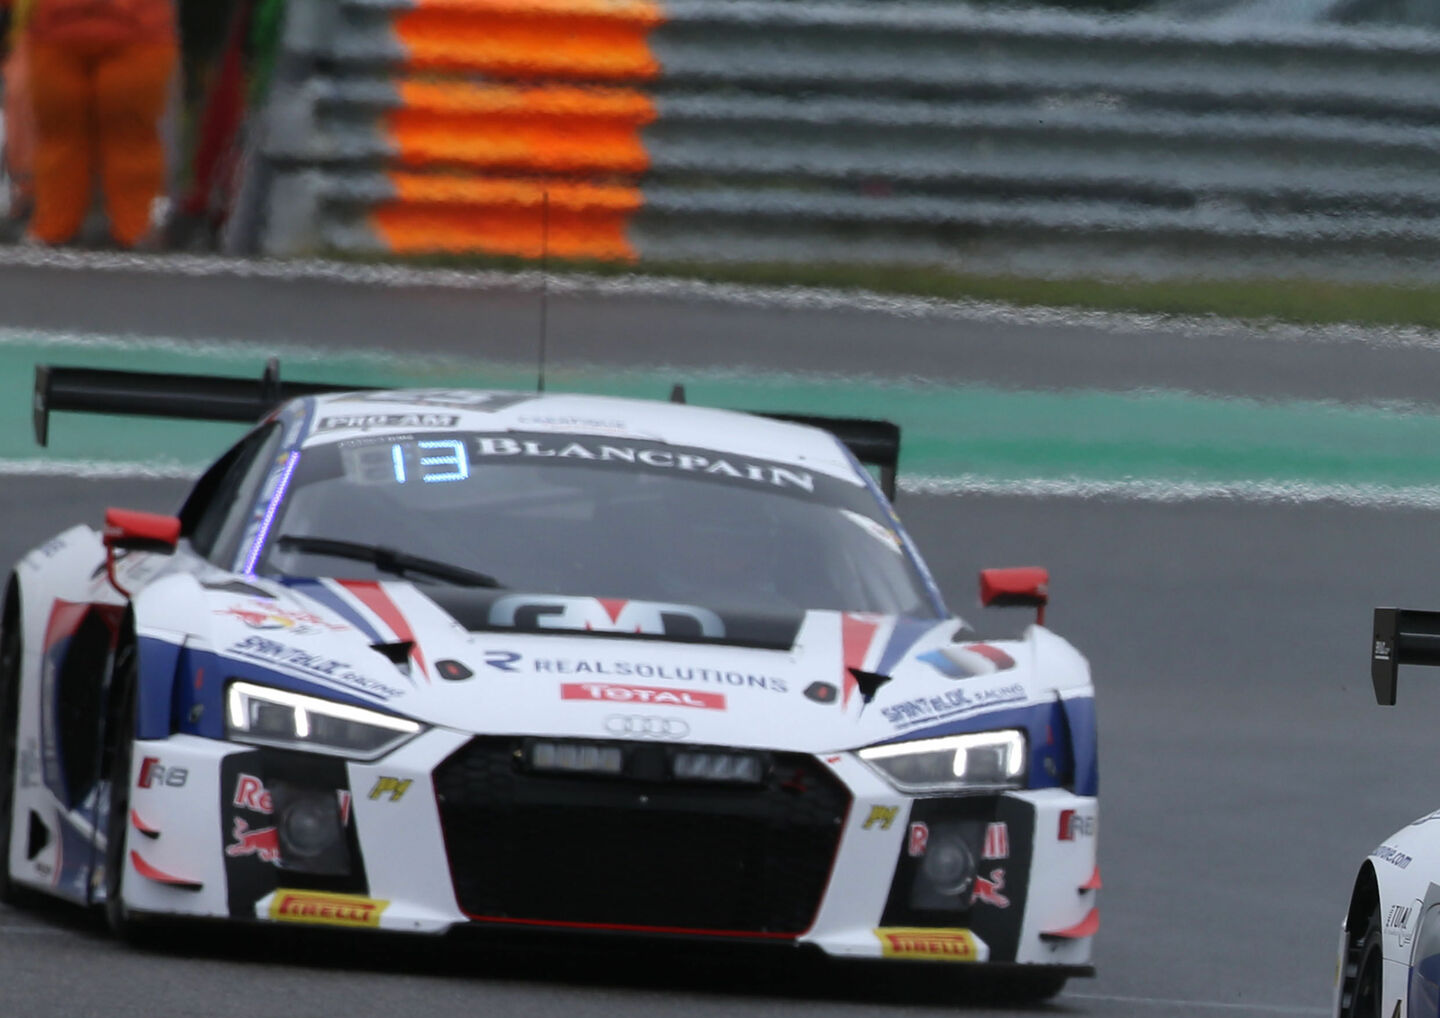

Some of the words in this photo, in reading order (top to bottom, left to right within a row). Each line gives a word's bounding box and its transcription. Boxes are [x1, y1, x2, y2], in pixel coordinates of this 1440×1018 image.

[391, 439, 470, 484] 13
[477, 437, 816, 493] BLANCPAIN
[582, 683, 706, 707] TOTAL
[278, 895, 378, 922] PIRELLI
[889, 933, 972, 957] PIRELLI
